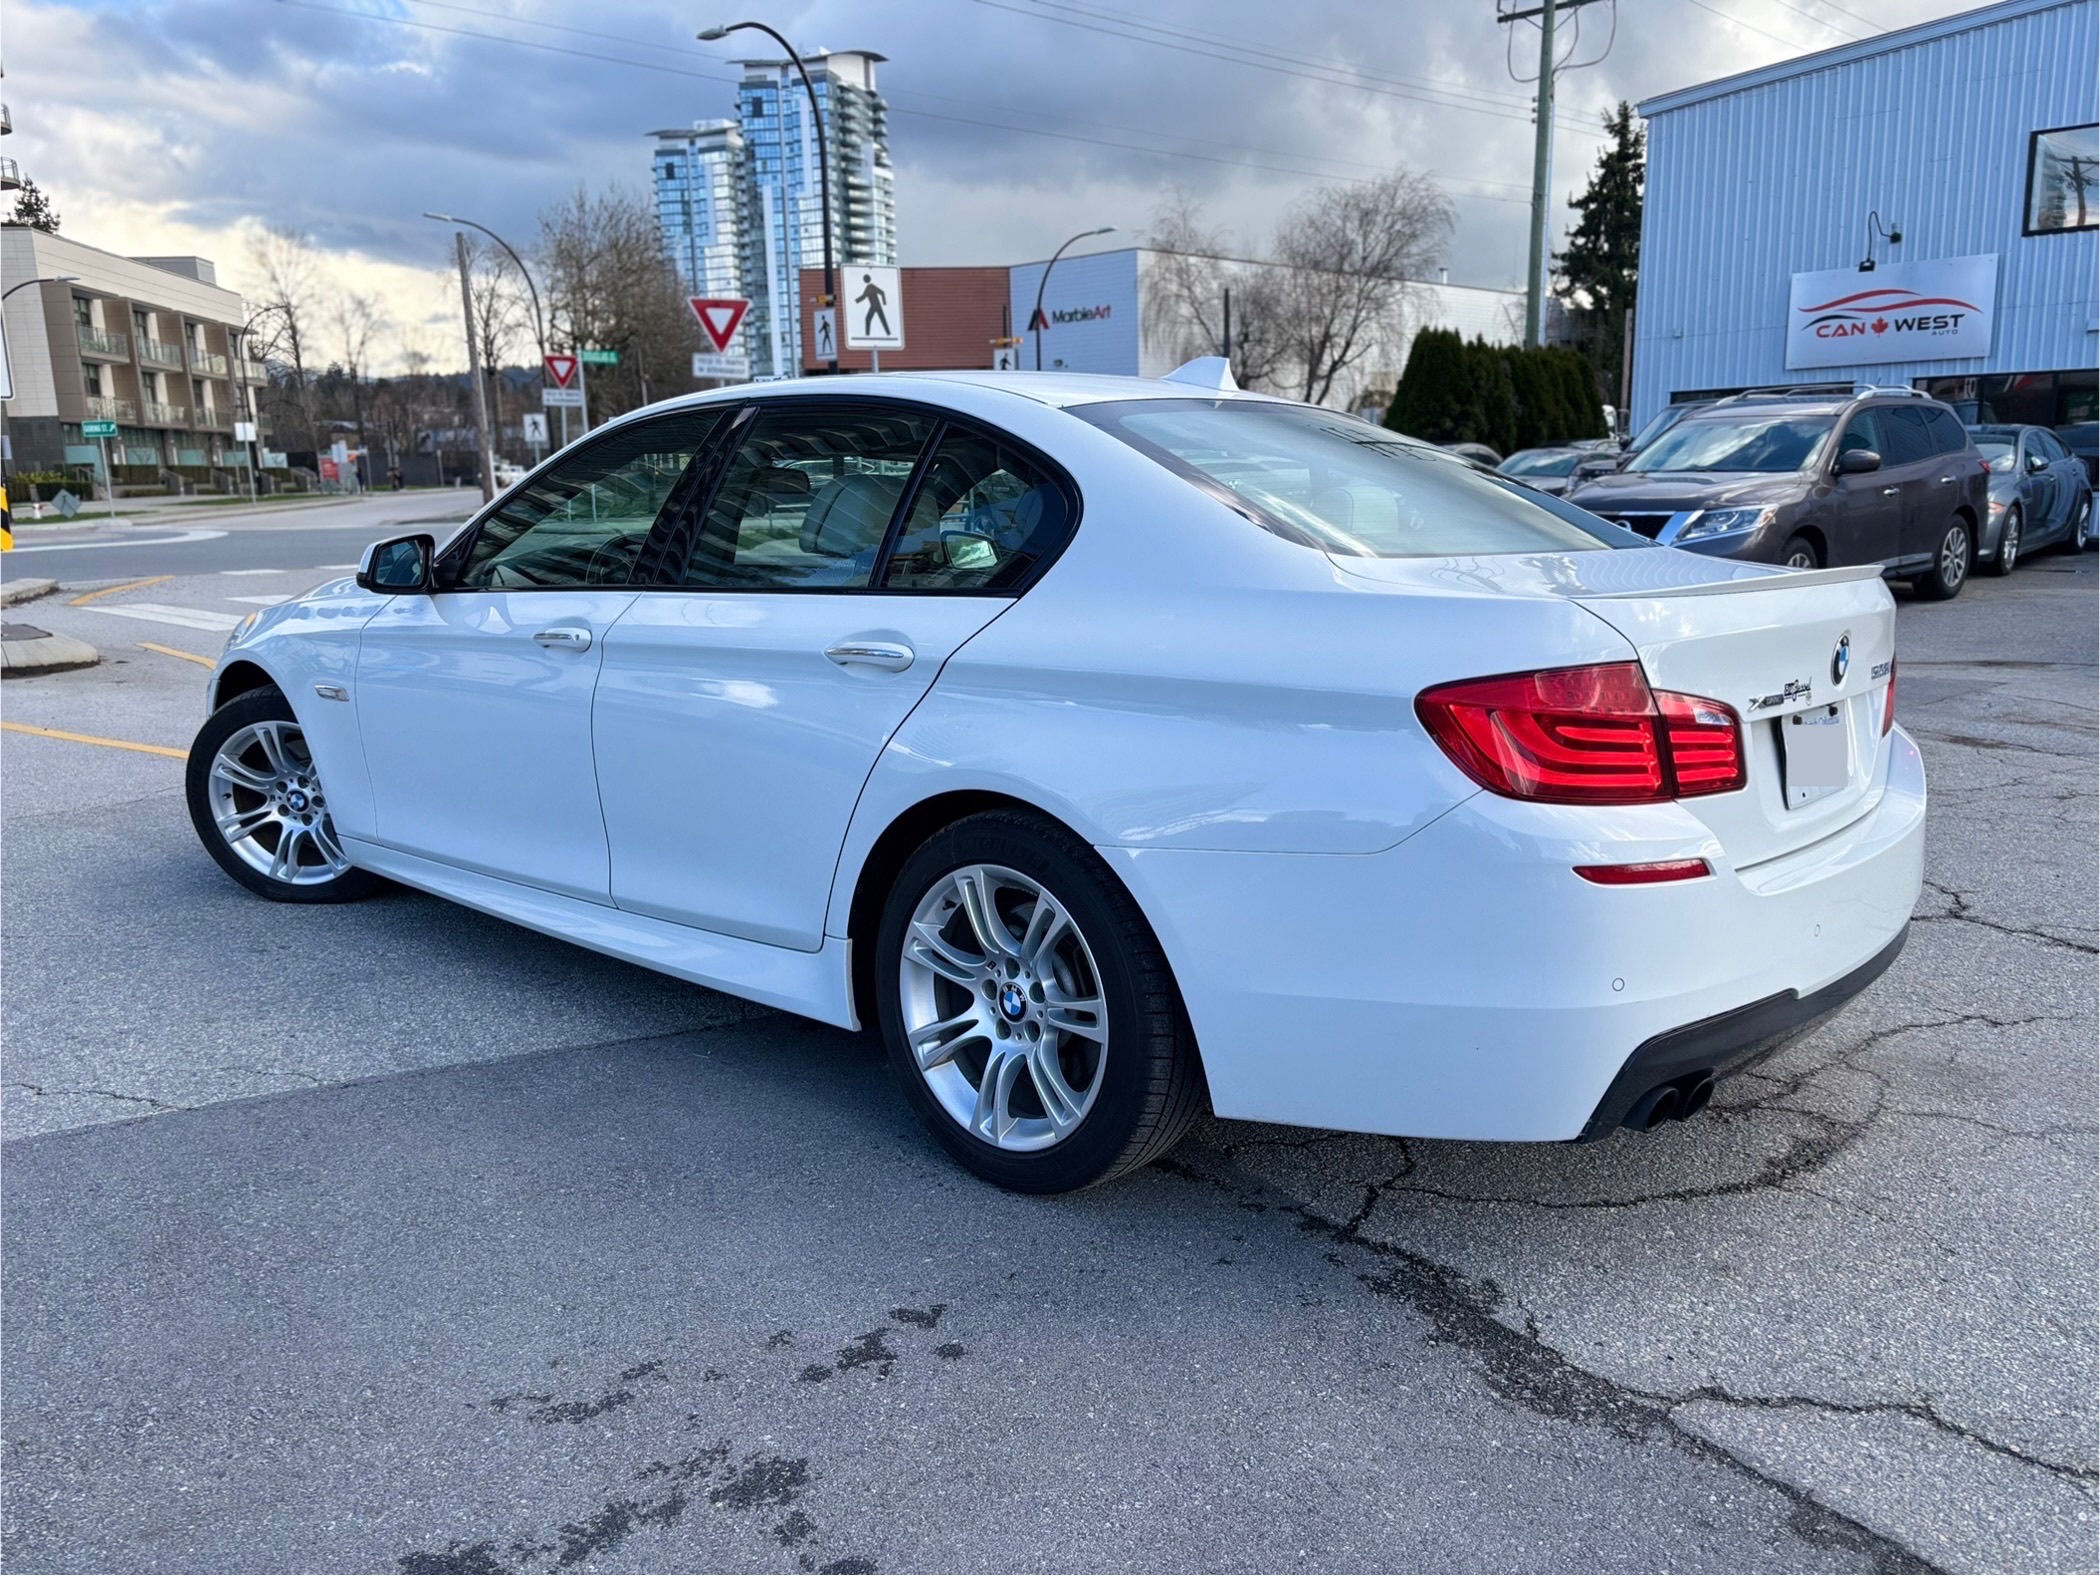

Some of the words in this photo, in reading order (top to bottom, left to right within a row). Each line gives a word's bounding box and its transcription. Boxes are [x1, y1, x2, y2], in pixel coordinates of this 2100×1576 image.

[1052, 304, 1111, 324] MarbleArt
[1816, 322, 1866, 338] CAN
[1894, 314, 1966, 332] WEST
[1003, 985, 1026, 1002] BMW
